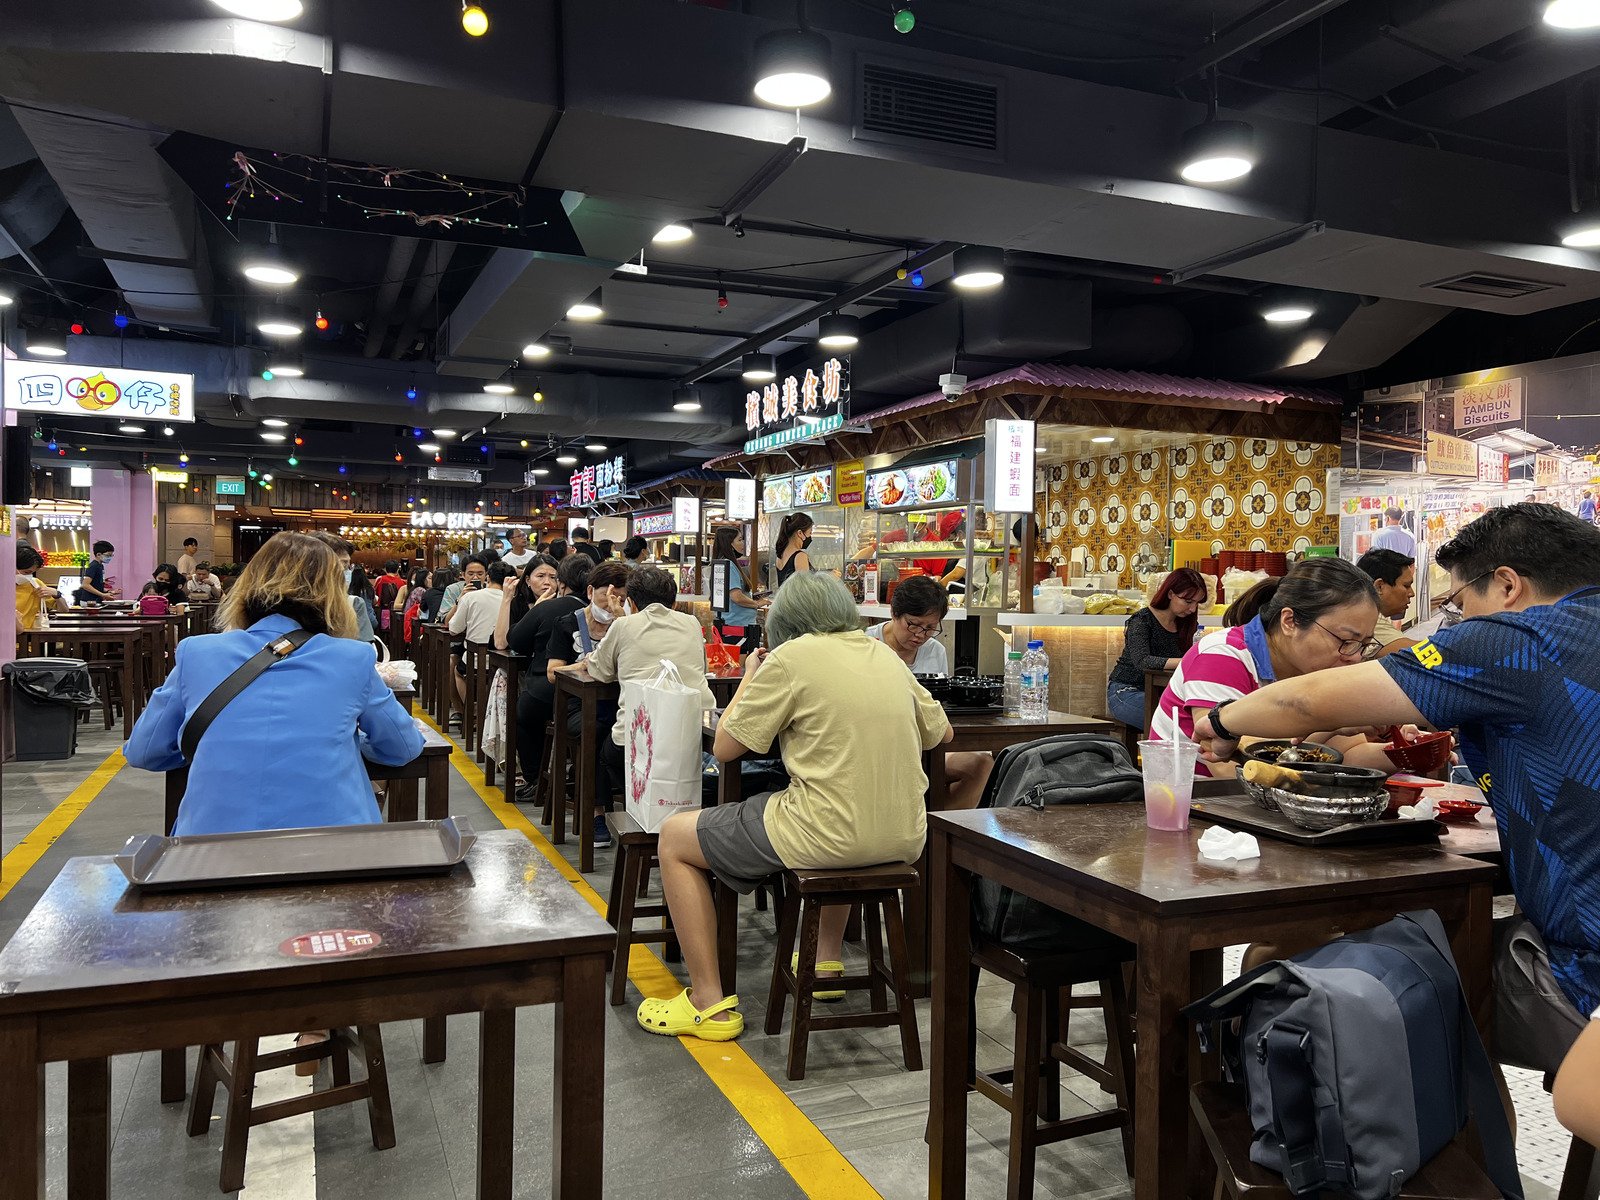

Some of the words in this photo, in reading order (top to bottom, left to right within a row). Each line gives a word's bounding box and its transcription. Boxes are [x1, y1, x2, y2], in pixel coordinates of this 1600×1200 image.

[18, 375, 62, 406] 四
[745, 358, 841, 431] 檳城美食坊
[1462, 383, 1512, 406] 淡汶餅
[1463, 399, 1511, 416] TAMBUN
[1464, 411, 1510, 426] Biscuits
[746, 436, 773, 454] PENANG
[776, 426, 807, 445] HAWKER
[810, 416, 838, 434] PLACE
[221, 483, 239, 492] EXIT
[841, 494, 851, 502] Order
[42, 517, 79, 526] FRUIT
